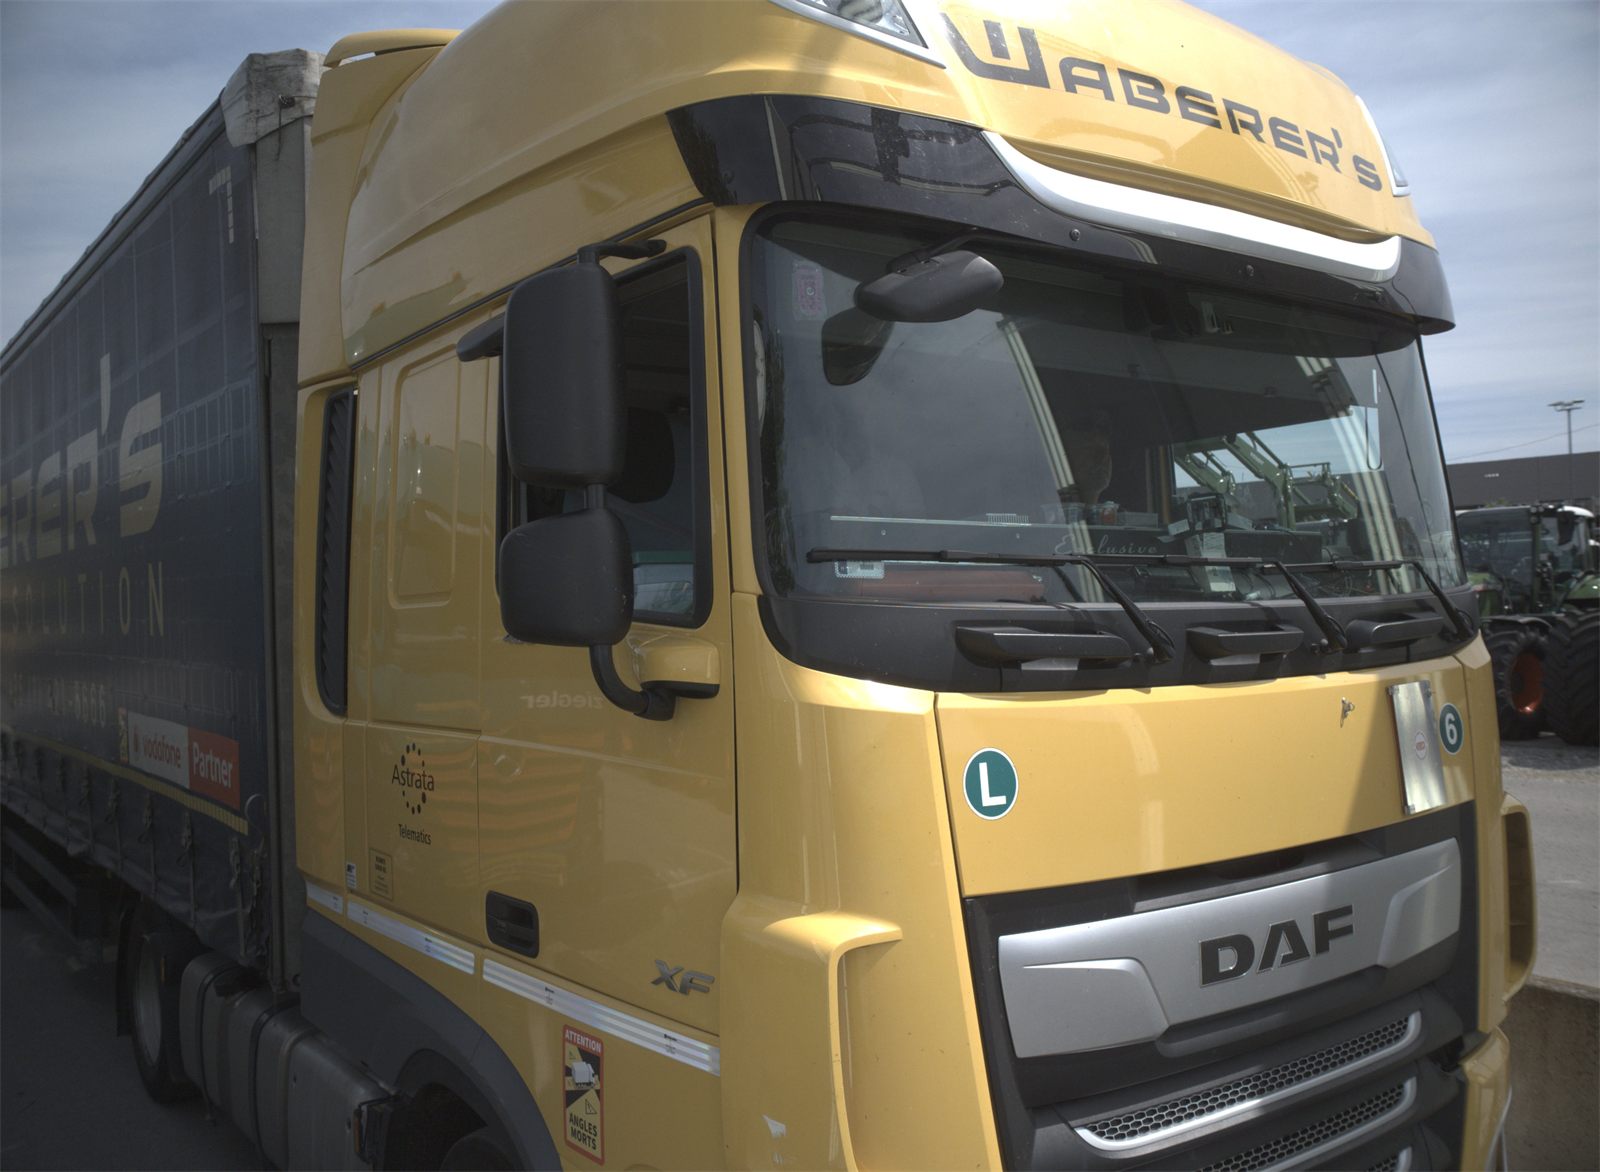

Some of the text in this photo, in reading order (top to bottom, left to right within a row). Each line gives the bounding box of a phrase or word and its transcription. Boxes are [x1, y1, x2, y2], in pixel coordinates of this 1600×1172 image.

[940, 12, 1383, 192] WABERER'S
[1054, 533, 1157, 555] Elusive
[1445, 712, 1458, 745] 6
[143, 735, 182, 769] vodafone
[192, 742, 233, 788] Partner
[391, 763, 435, 792] Astrata
[978, 762, 1007, 808] L
[398, 823, 432, 846] Telematics
[1200, 905, 1354, 987] DAF
[651, 959, 716, 996] XF
[565, 1029, 601, 1053] ATTENTION
[569, 1113, 598, 1138] ANGLES
[570, 1126, 598, 1151] MORTS
